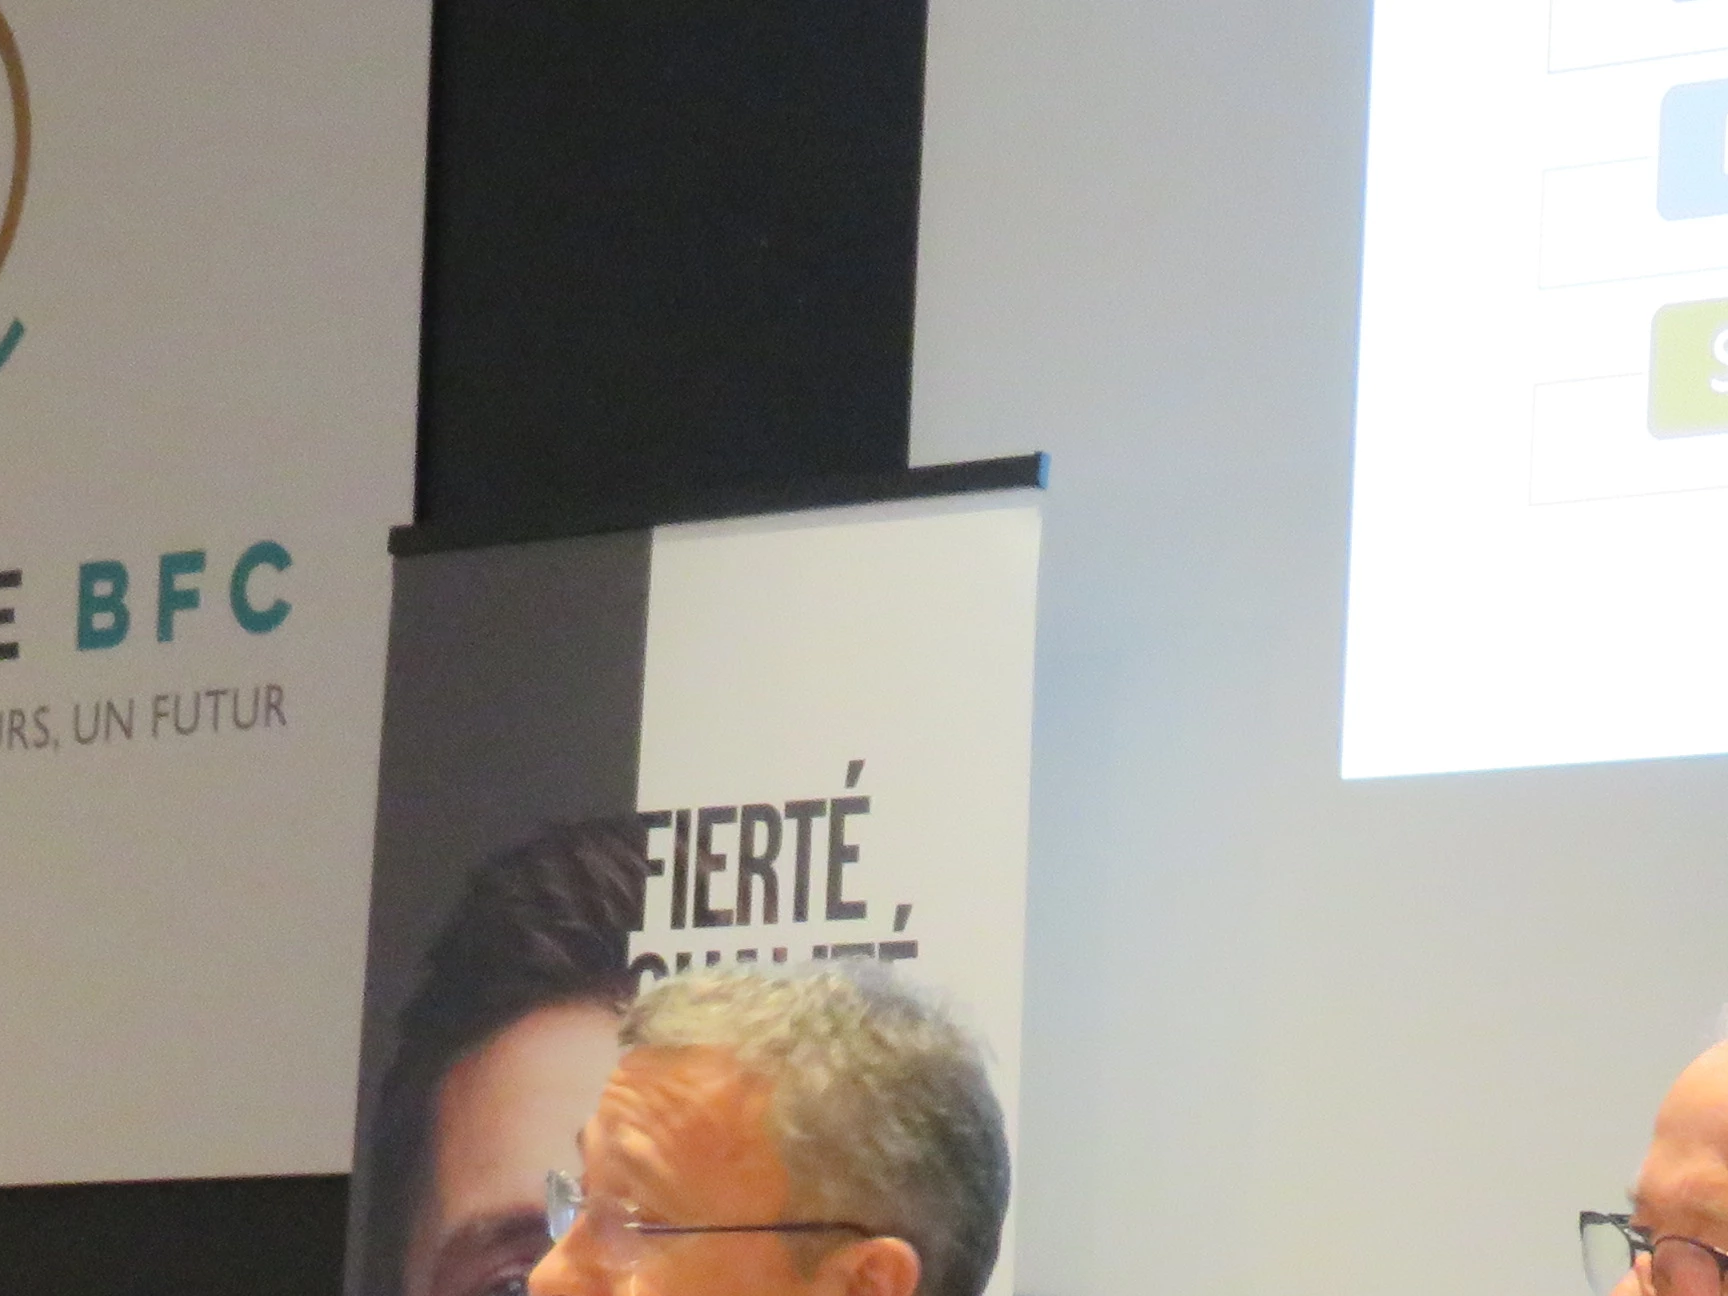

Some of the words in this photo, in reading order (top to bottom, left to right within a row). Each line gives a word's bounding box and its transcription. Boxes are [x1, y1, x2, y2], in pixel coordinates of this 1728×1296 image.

[76, 541, 294, 652] BFC
[75, 700, 134, 745] UN
[151, 684, 288, 738] FUTUR
[634, 759, 871, 930] FIERTÉ
